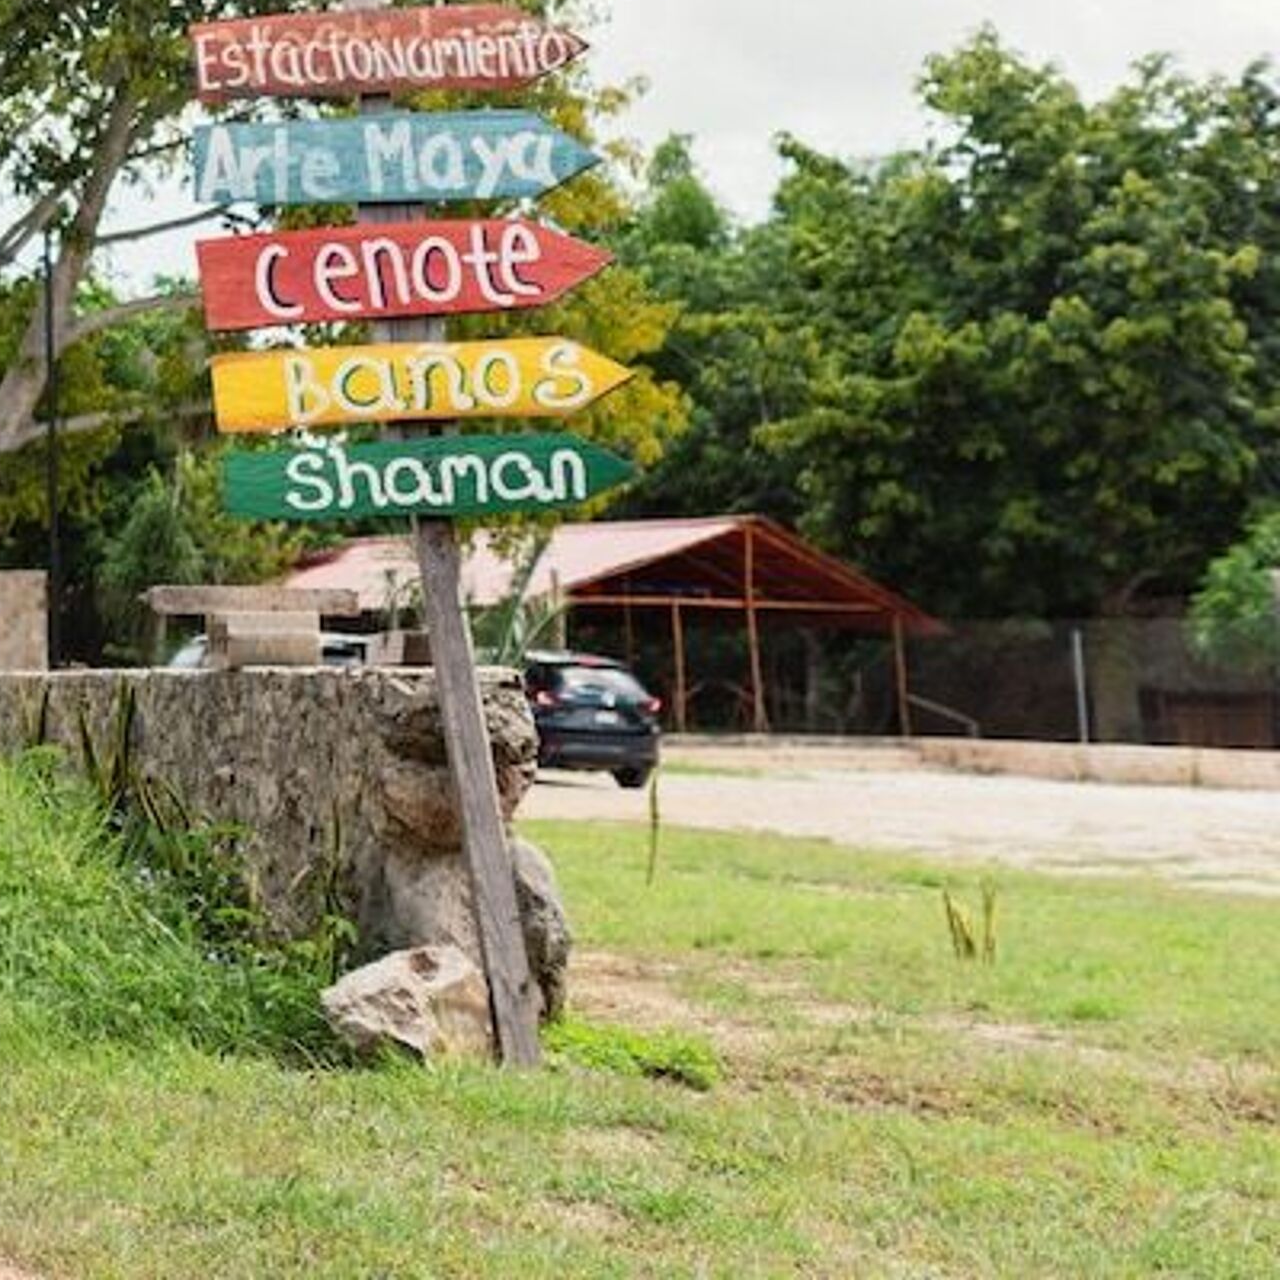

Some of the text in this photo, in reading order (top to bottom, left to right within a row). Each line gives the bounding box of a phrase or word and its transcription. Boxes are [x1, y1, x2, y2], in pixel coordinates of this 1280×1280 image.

[200, 119, 558, 202] Arte Maya
[285, 340, 592, 419] Baños
[286, 444, 587, 510] Shaman
